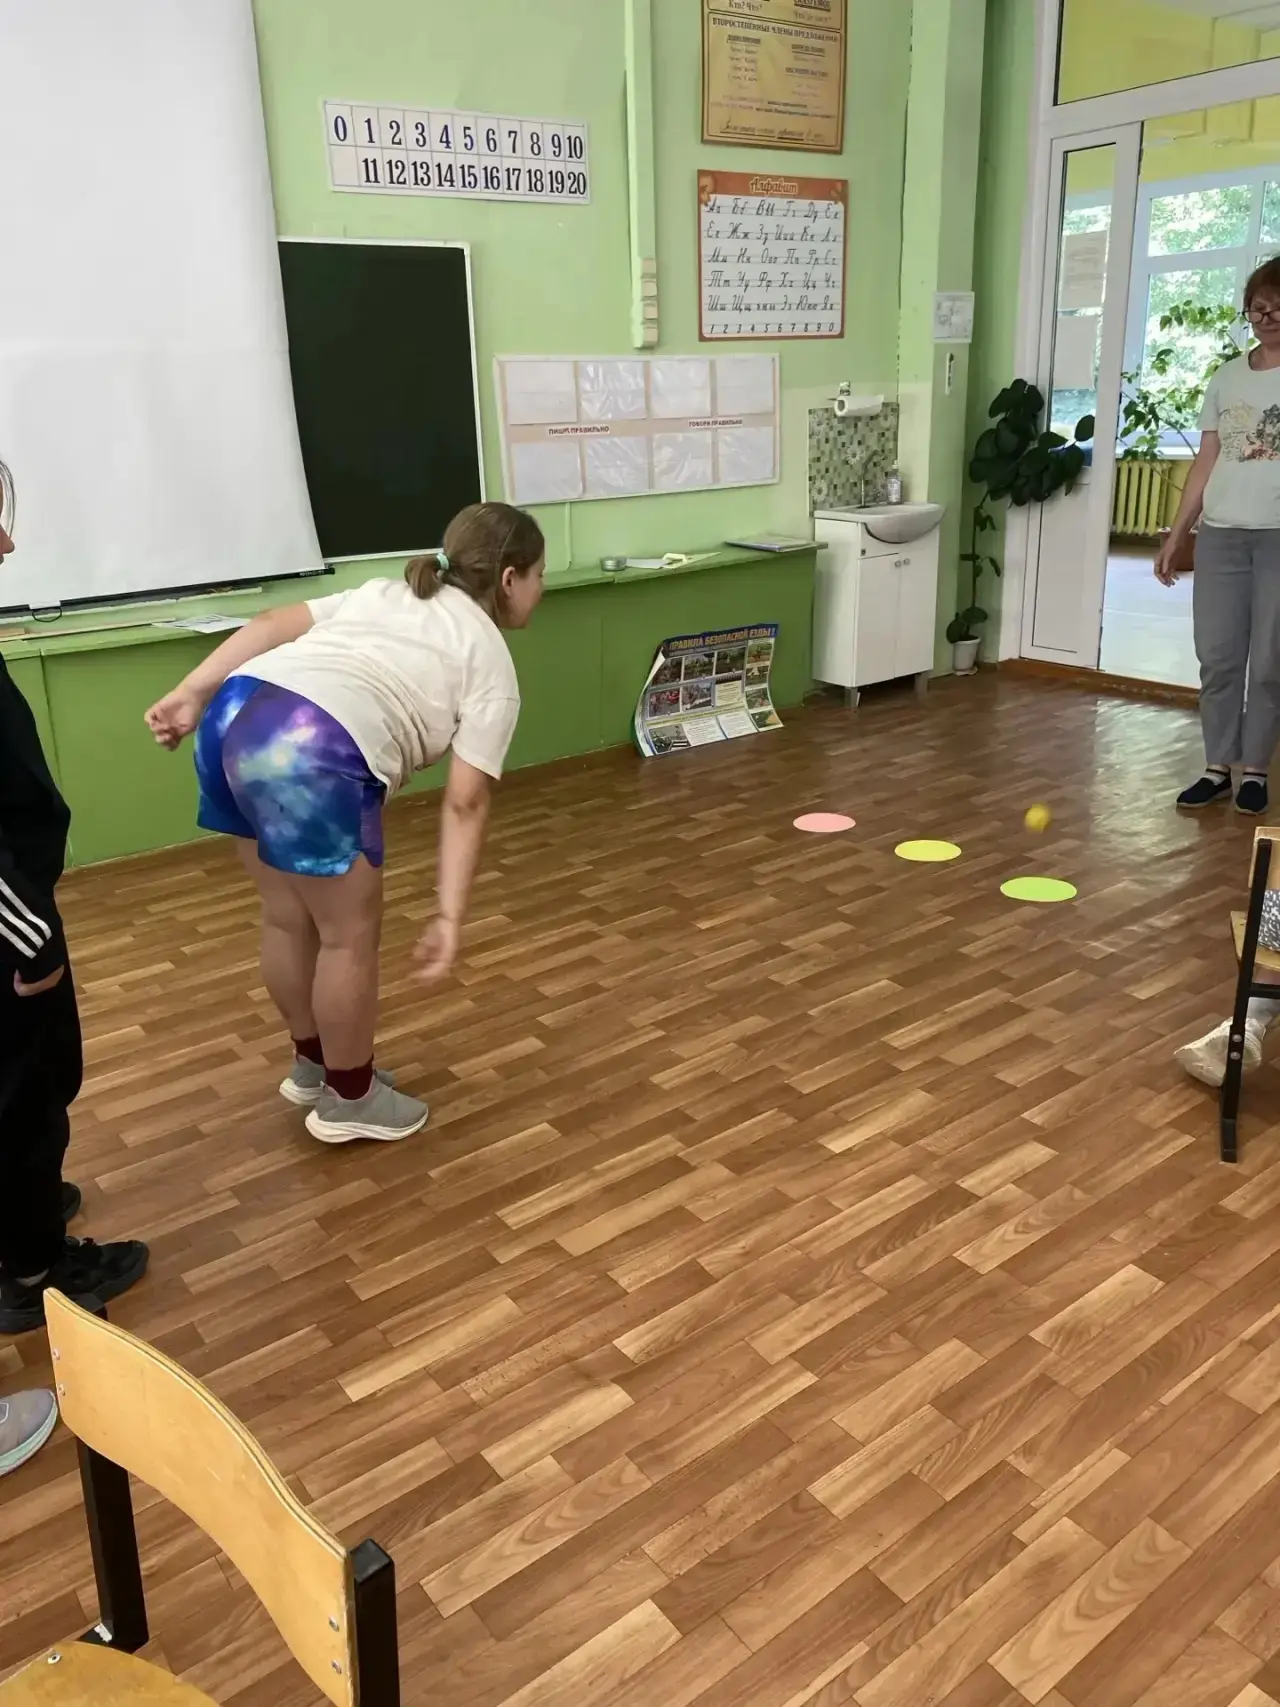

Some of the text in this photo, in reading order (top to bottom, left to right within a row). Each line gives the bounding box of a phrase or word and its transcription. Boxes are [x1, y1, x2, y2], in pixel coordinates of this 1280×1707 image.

[334, 115, 583, 159] 0 1 2 3 4 5 6 7 8 9 10
[362, 158, 587, 195] 11 12 13 14 15 16 17 18 19 20
[750, 177, 798, 197] Алфавит
[710, 322, 834, 334] 1 2 3 4 5 6 7 8 9 0
[571, 425, 610, 434] ПРАВИЛЬНО
[688, 420, 711, 428] ГОВОРИ
[670, 637, 703, 650] ПРАВИЛА
[705, 629, 748, 645] БЕЗОПАСНОЙ
